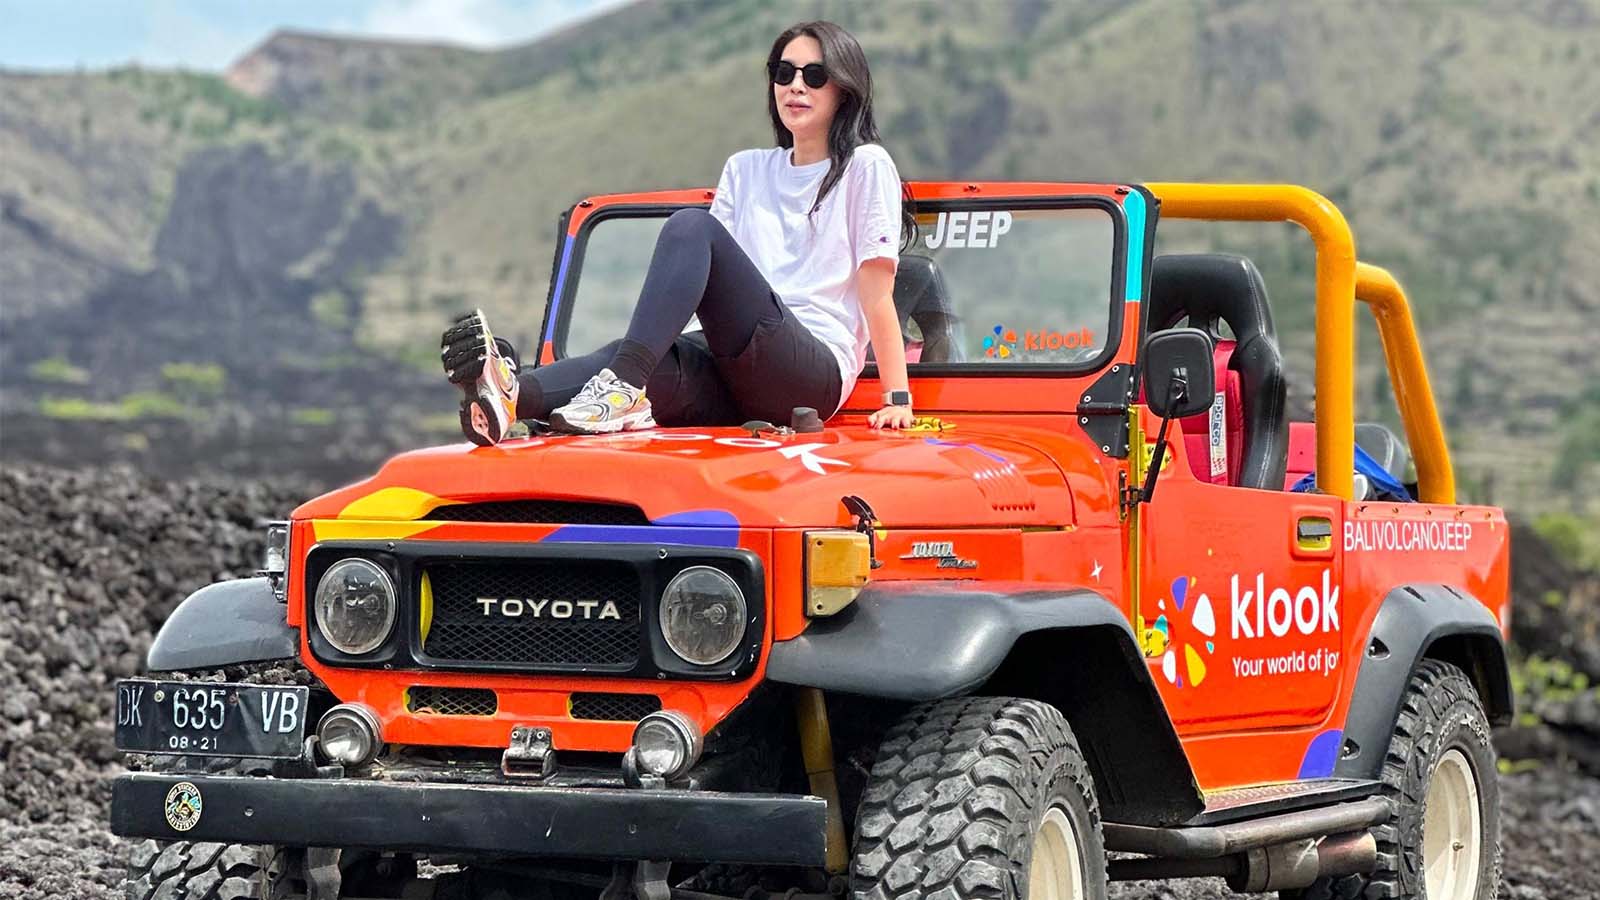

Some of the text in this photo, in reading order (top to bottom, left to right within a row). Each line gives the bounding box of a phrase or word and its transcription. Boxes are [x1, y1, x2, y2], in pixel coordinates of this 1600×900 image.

[925, 211, 1013, 249] JEEP
[1024, 326, 1095, 352] klook
[912, 540, 954, 557] TOYOTA
[1343, 520, 1473, 552] BALIVOLCANOJEEP
[476, 596, 622, 621] TOYOTA
[1230, 568, 1340, 640] klook
[1231, 647, 1340, 678] Your world of jo
[117, 685, 300, 734] DK 635 VB
